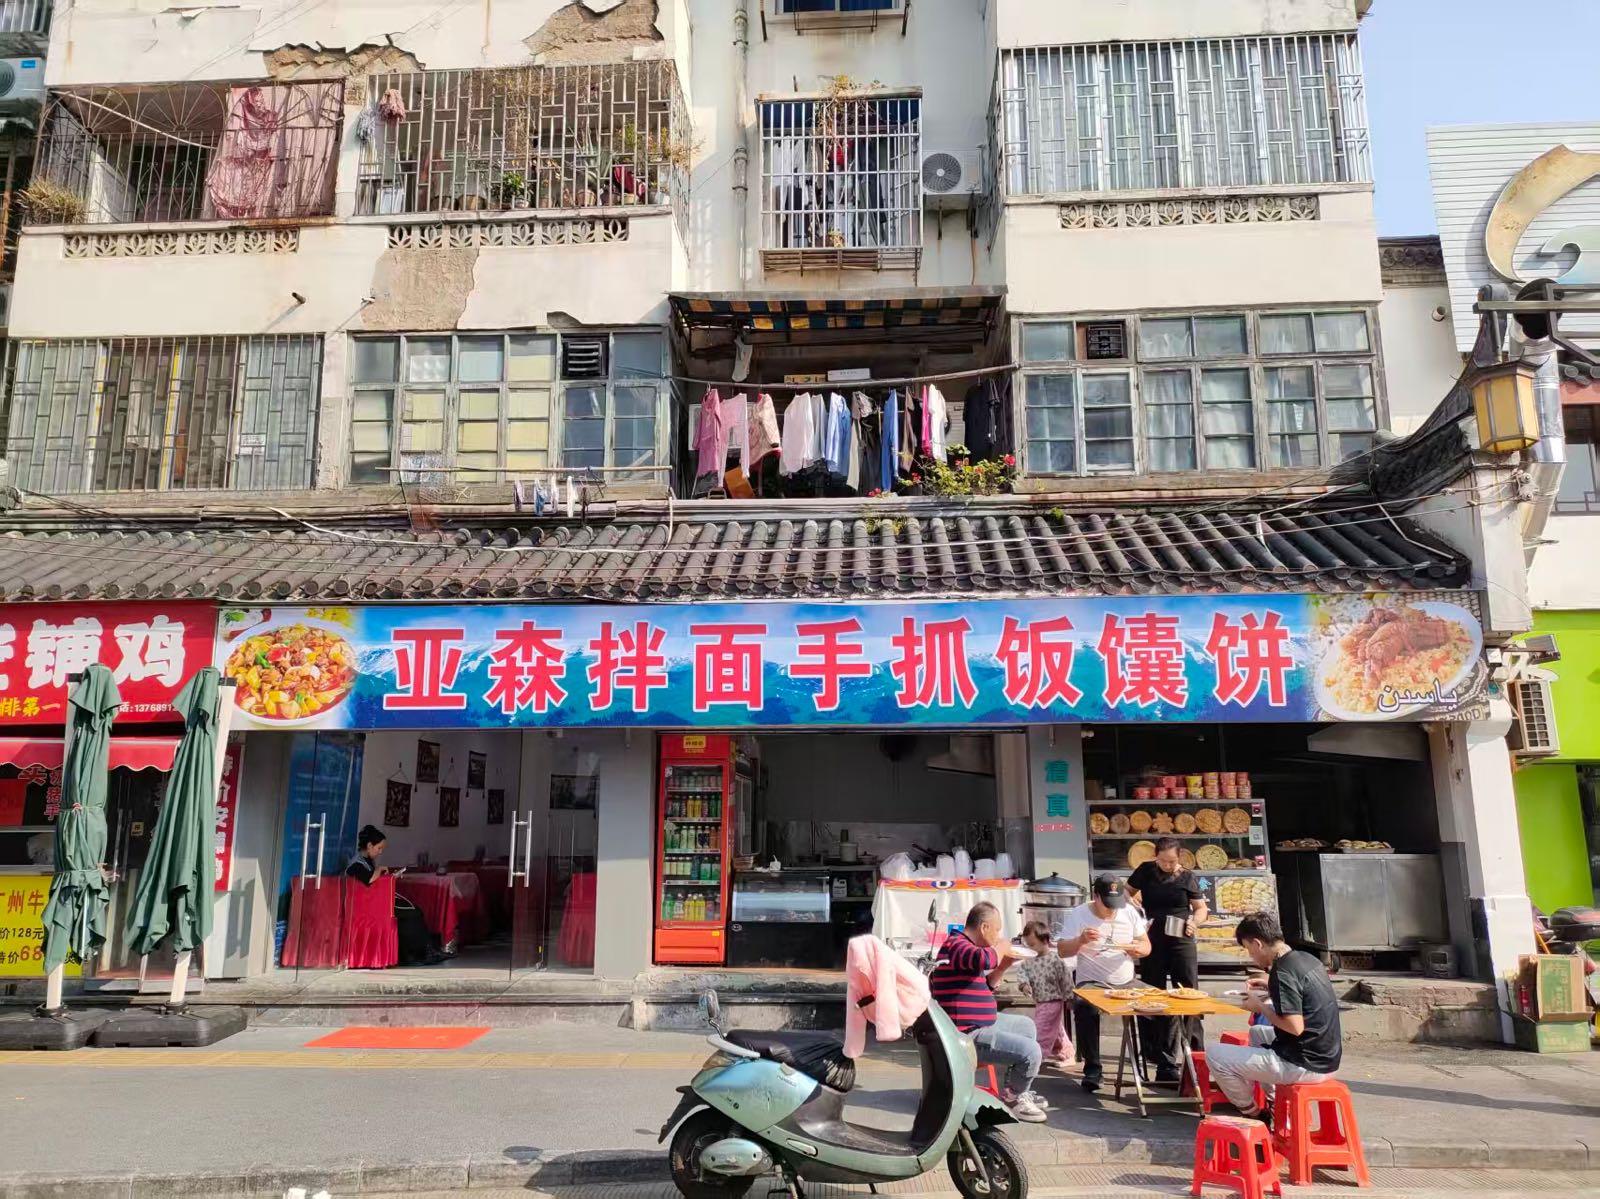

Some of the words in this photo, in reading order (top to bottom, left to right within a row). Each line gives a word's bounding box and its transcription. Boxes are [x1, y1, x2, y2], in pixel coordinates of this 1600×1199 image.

[382, 611, 1295, 713] 亚森拌面手抓饭馕饼
[1044, 760, 1070, 817] 清真
